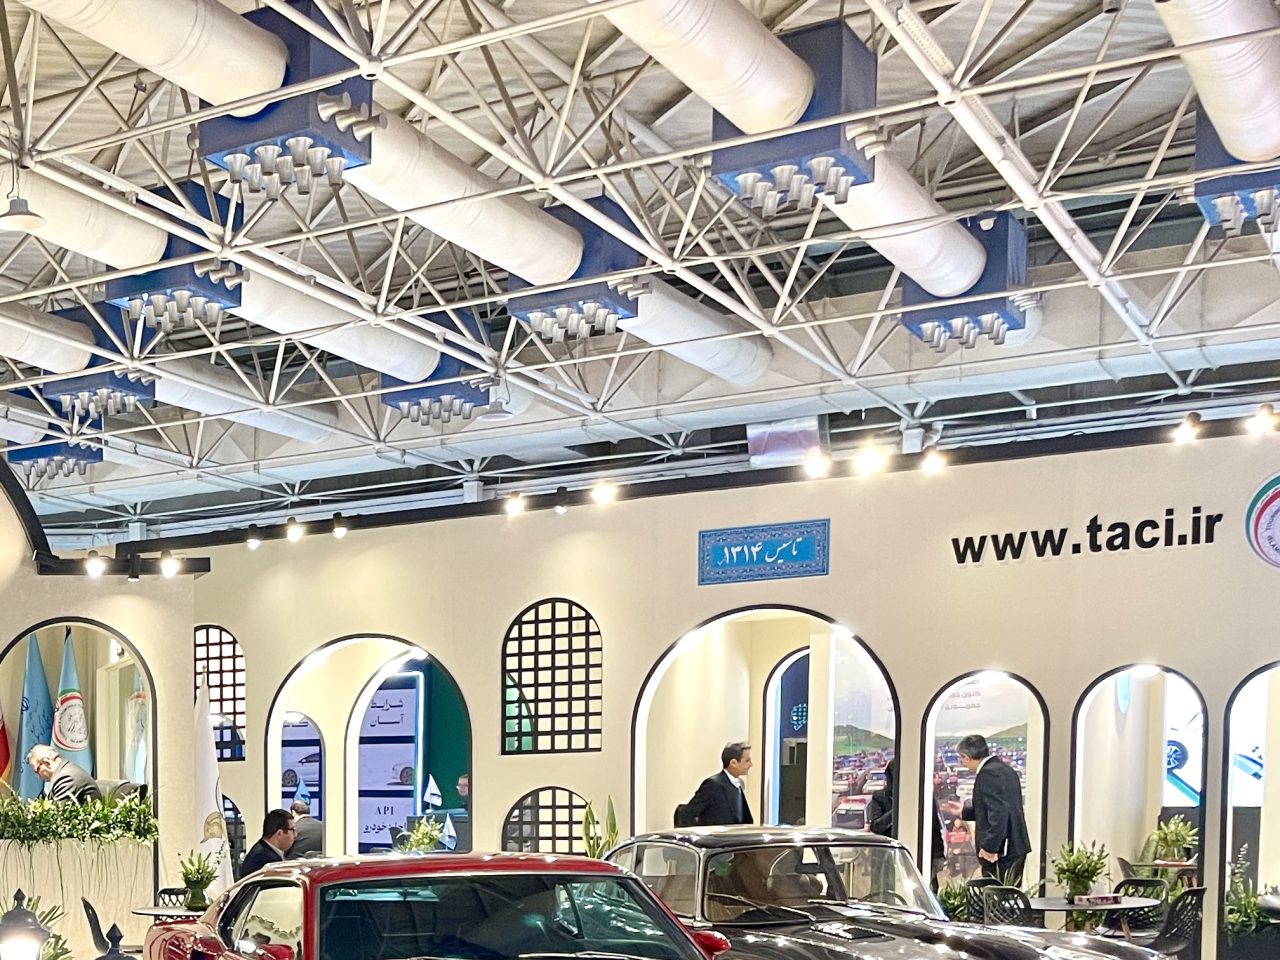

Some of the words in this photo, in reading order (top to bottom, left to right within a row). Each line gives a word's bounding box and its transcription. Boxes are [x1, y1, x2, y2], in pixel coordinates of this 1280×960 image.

[951, 506, 1223, 564] www.taci.ir
[723, 542, 764, 564] ۱۳۱۴
[370, 713, 405, 728] آسان
[376, 805, 394, 816] API
